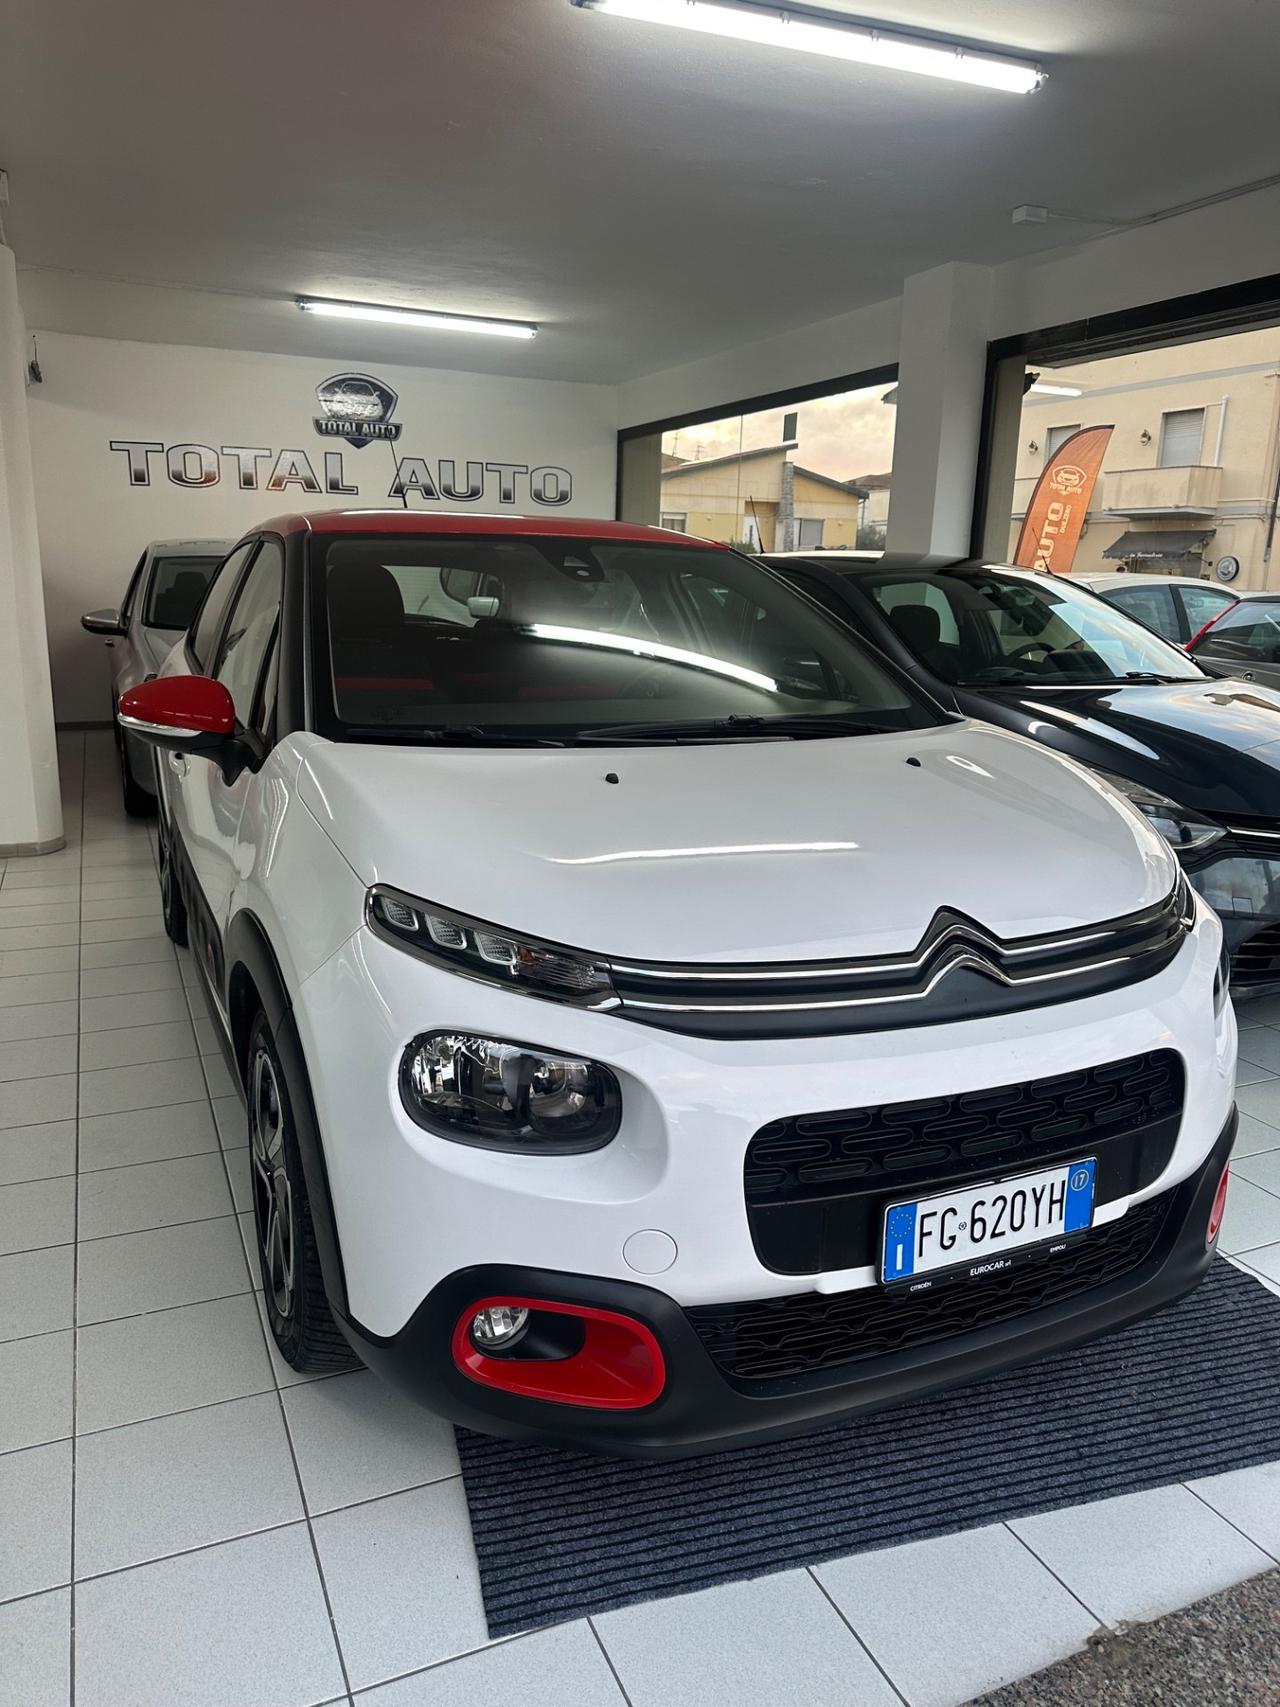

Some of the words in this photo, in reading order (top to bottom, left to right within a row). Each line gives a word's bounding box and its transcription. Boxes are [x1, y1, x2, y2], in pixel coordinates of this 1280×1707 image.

[320, 420, 357, 435] TOTAL
[362, 423, 396, 438] AUTO
[110, 440, 358, 495] TOTAL
[388, 457, 573, 506] AUTO
[1033, 502, 1064, 573] AUTO
[1074, 1173, 1086, 1188] 17
[969, 1260, 1005, 1277] EUROCAR
